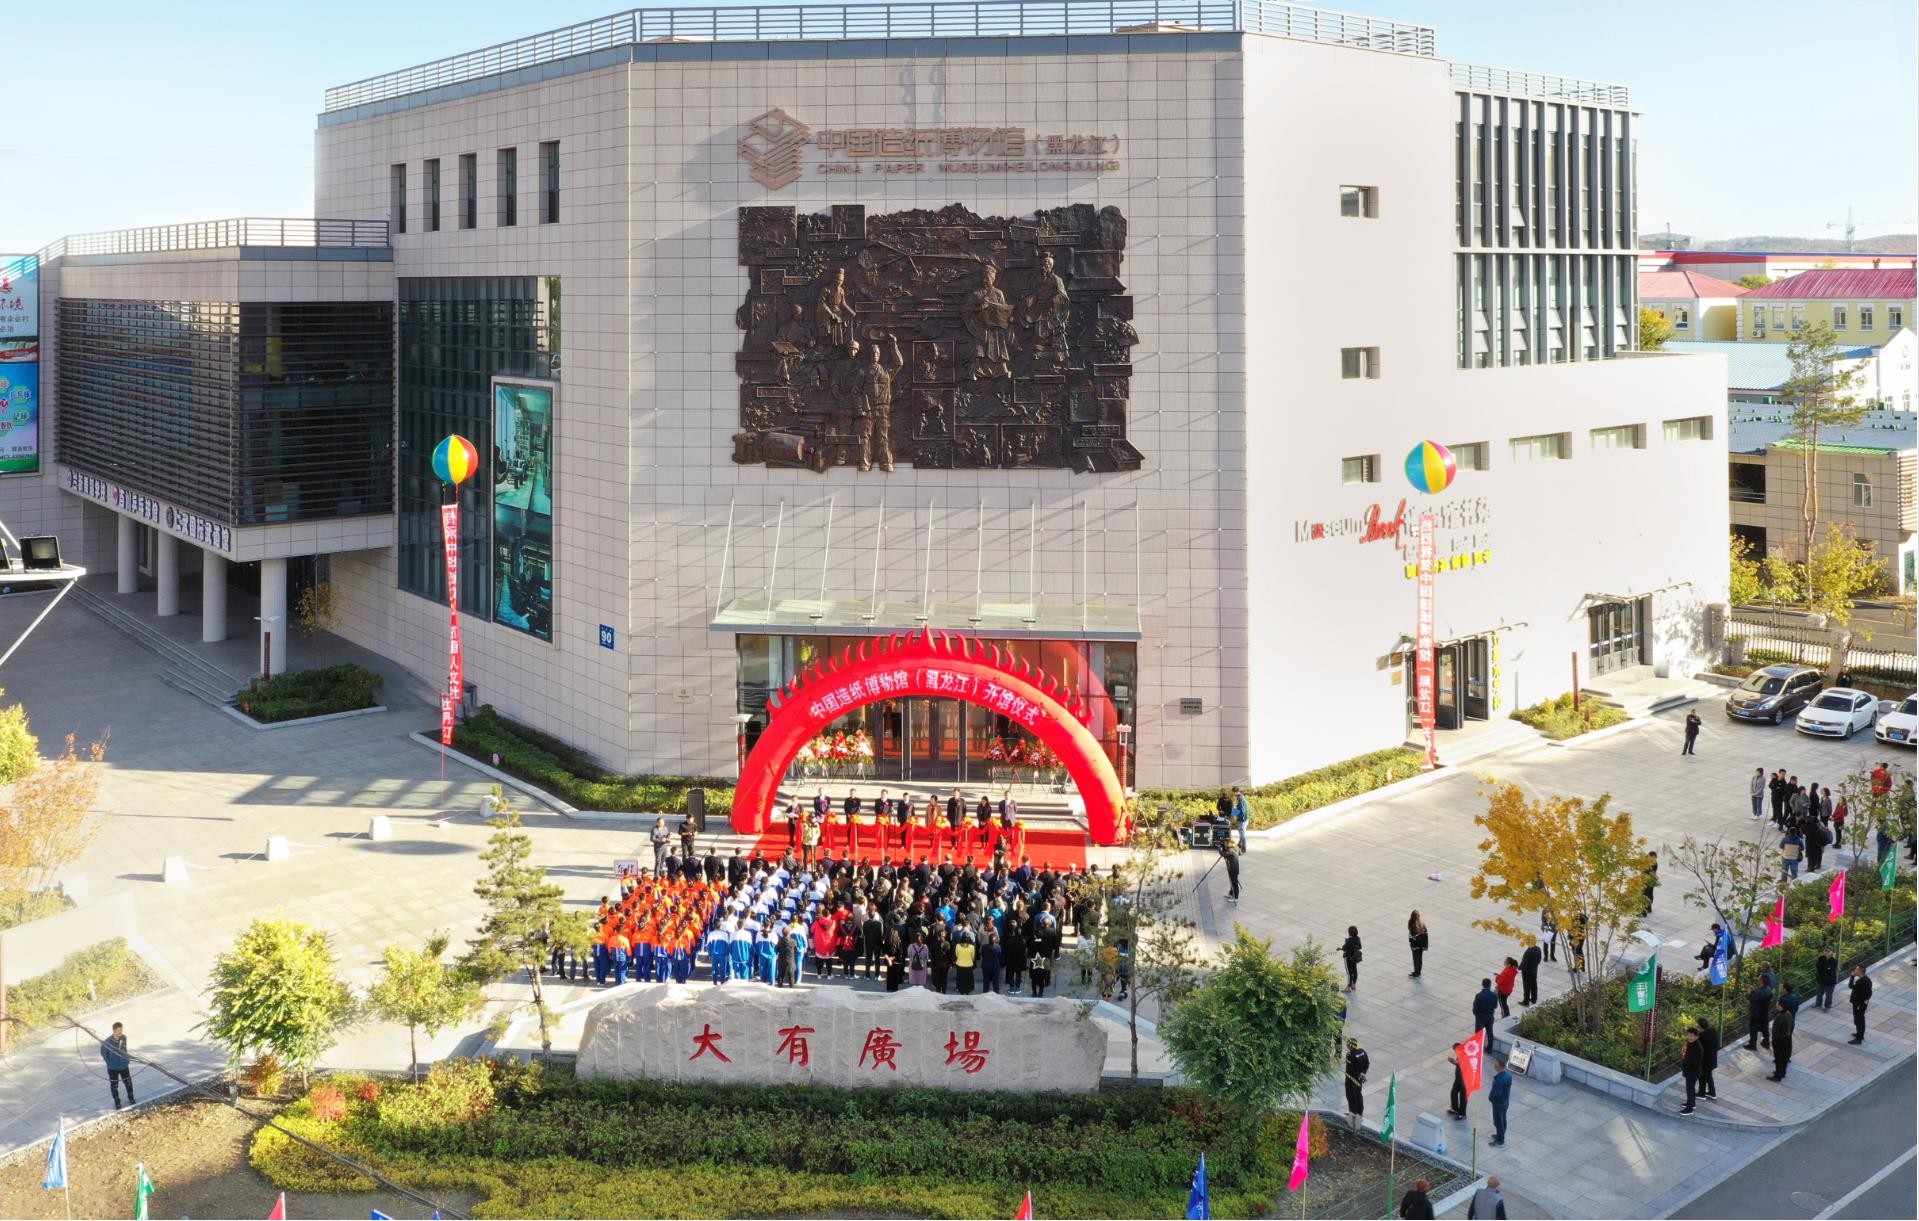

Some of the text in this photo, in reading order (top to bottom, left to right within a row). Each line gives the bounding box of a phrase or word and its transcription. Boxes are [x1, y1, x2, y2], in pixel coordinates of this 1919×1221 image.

[817, 163, 863, 175] CHINA
[875, 163, 925, 174] PAPER
[602, 631, 611, 644] 90
